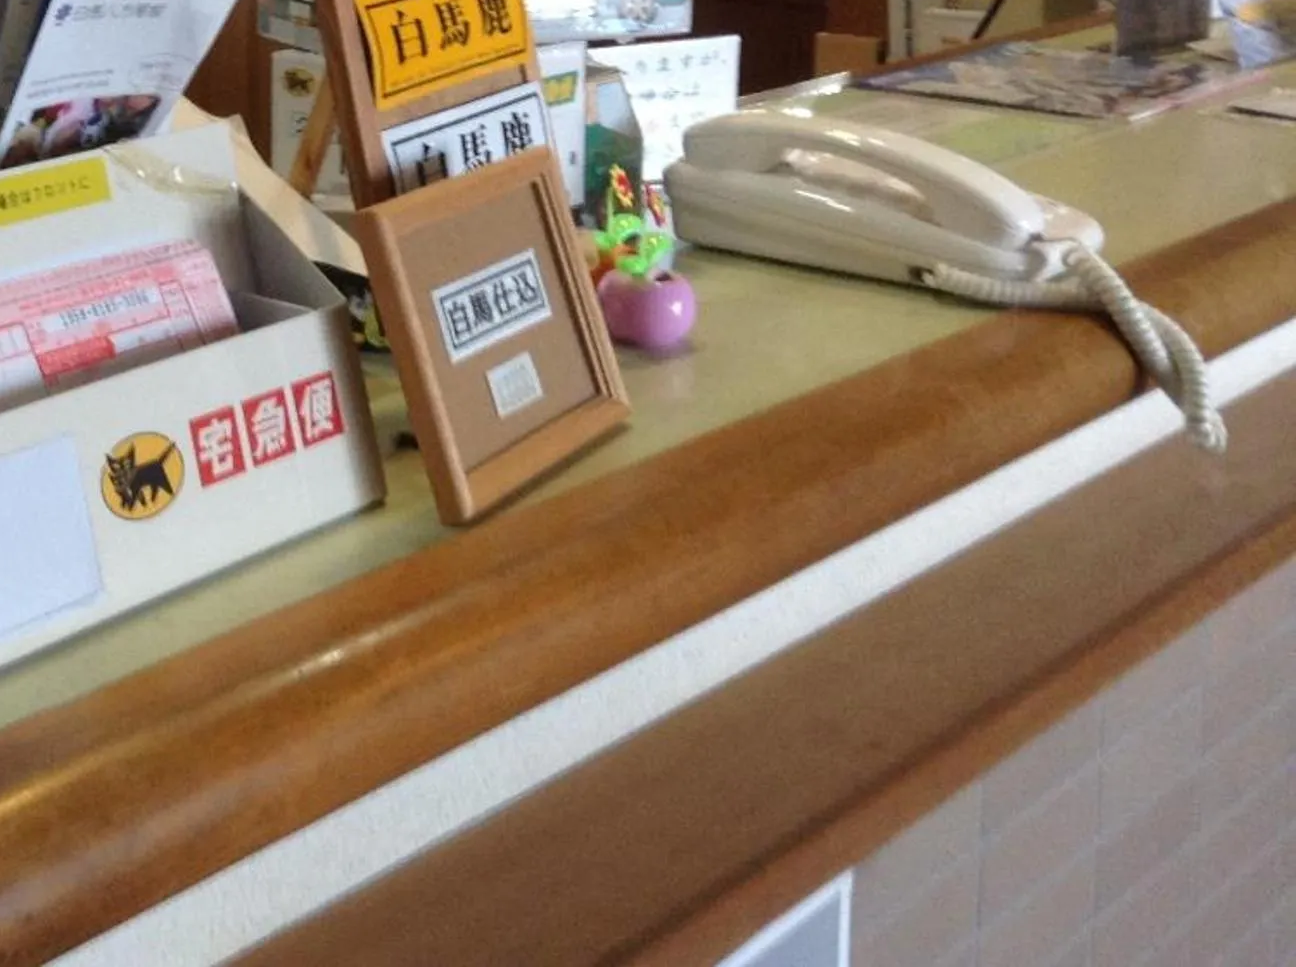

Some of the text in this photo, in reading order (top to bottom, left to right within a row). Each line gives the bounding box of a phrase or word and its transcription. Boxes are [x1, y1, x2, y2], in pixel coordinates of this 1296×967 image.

[447, 271, 538, 339] 白馬仕込
[196, 377, 335, 479] 宅急便
